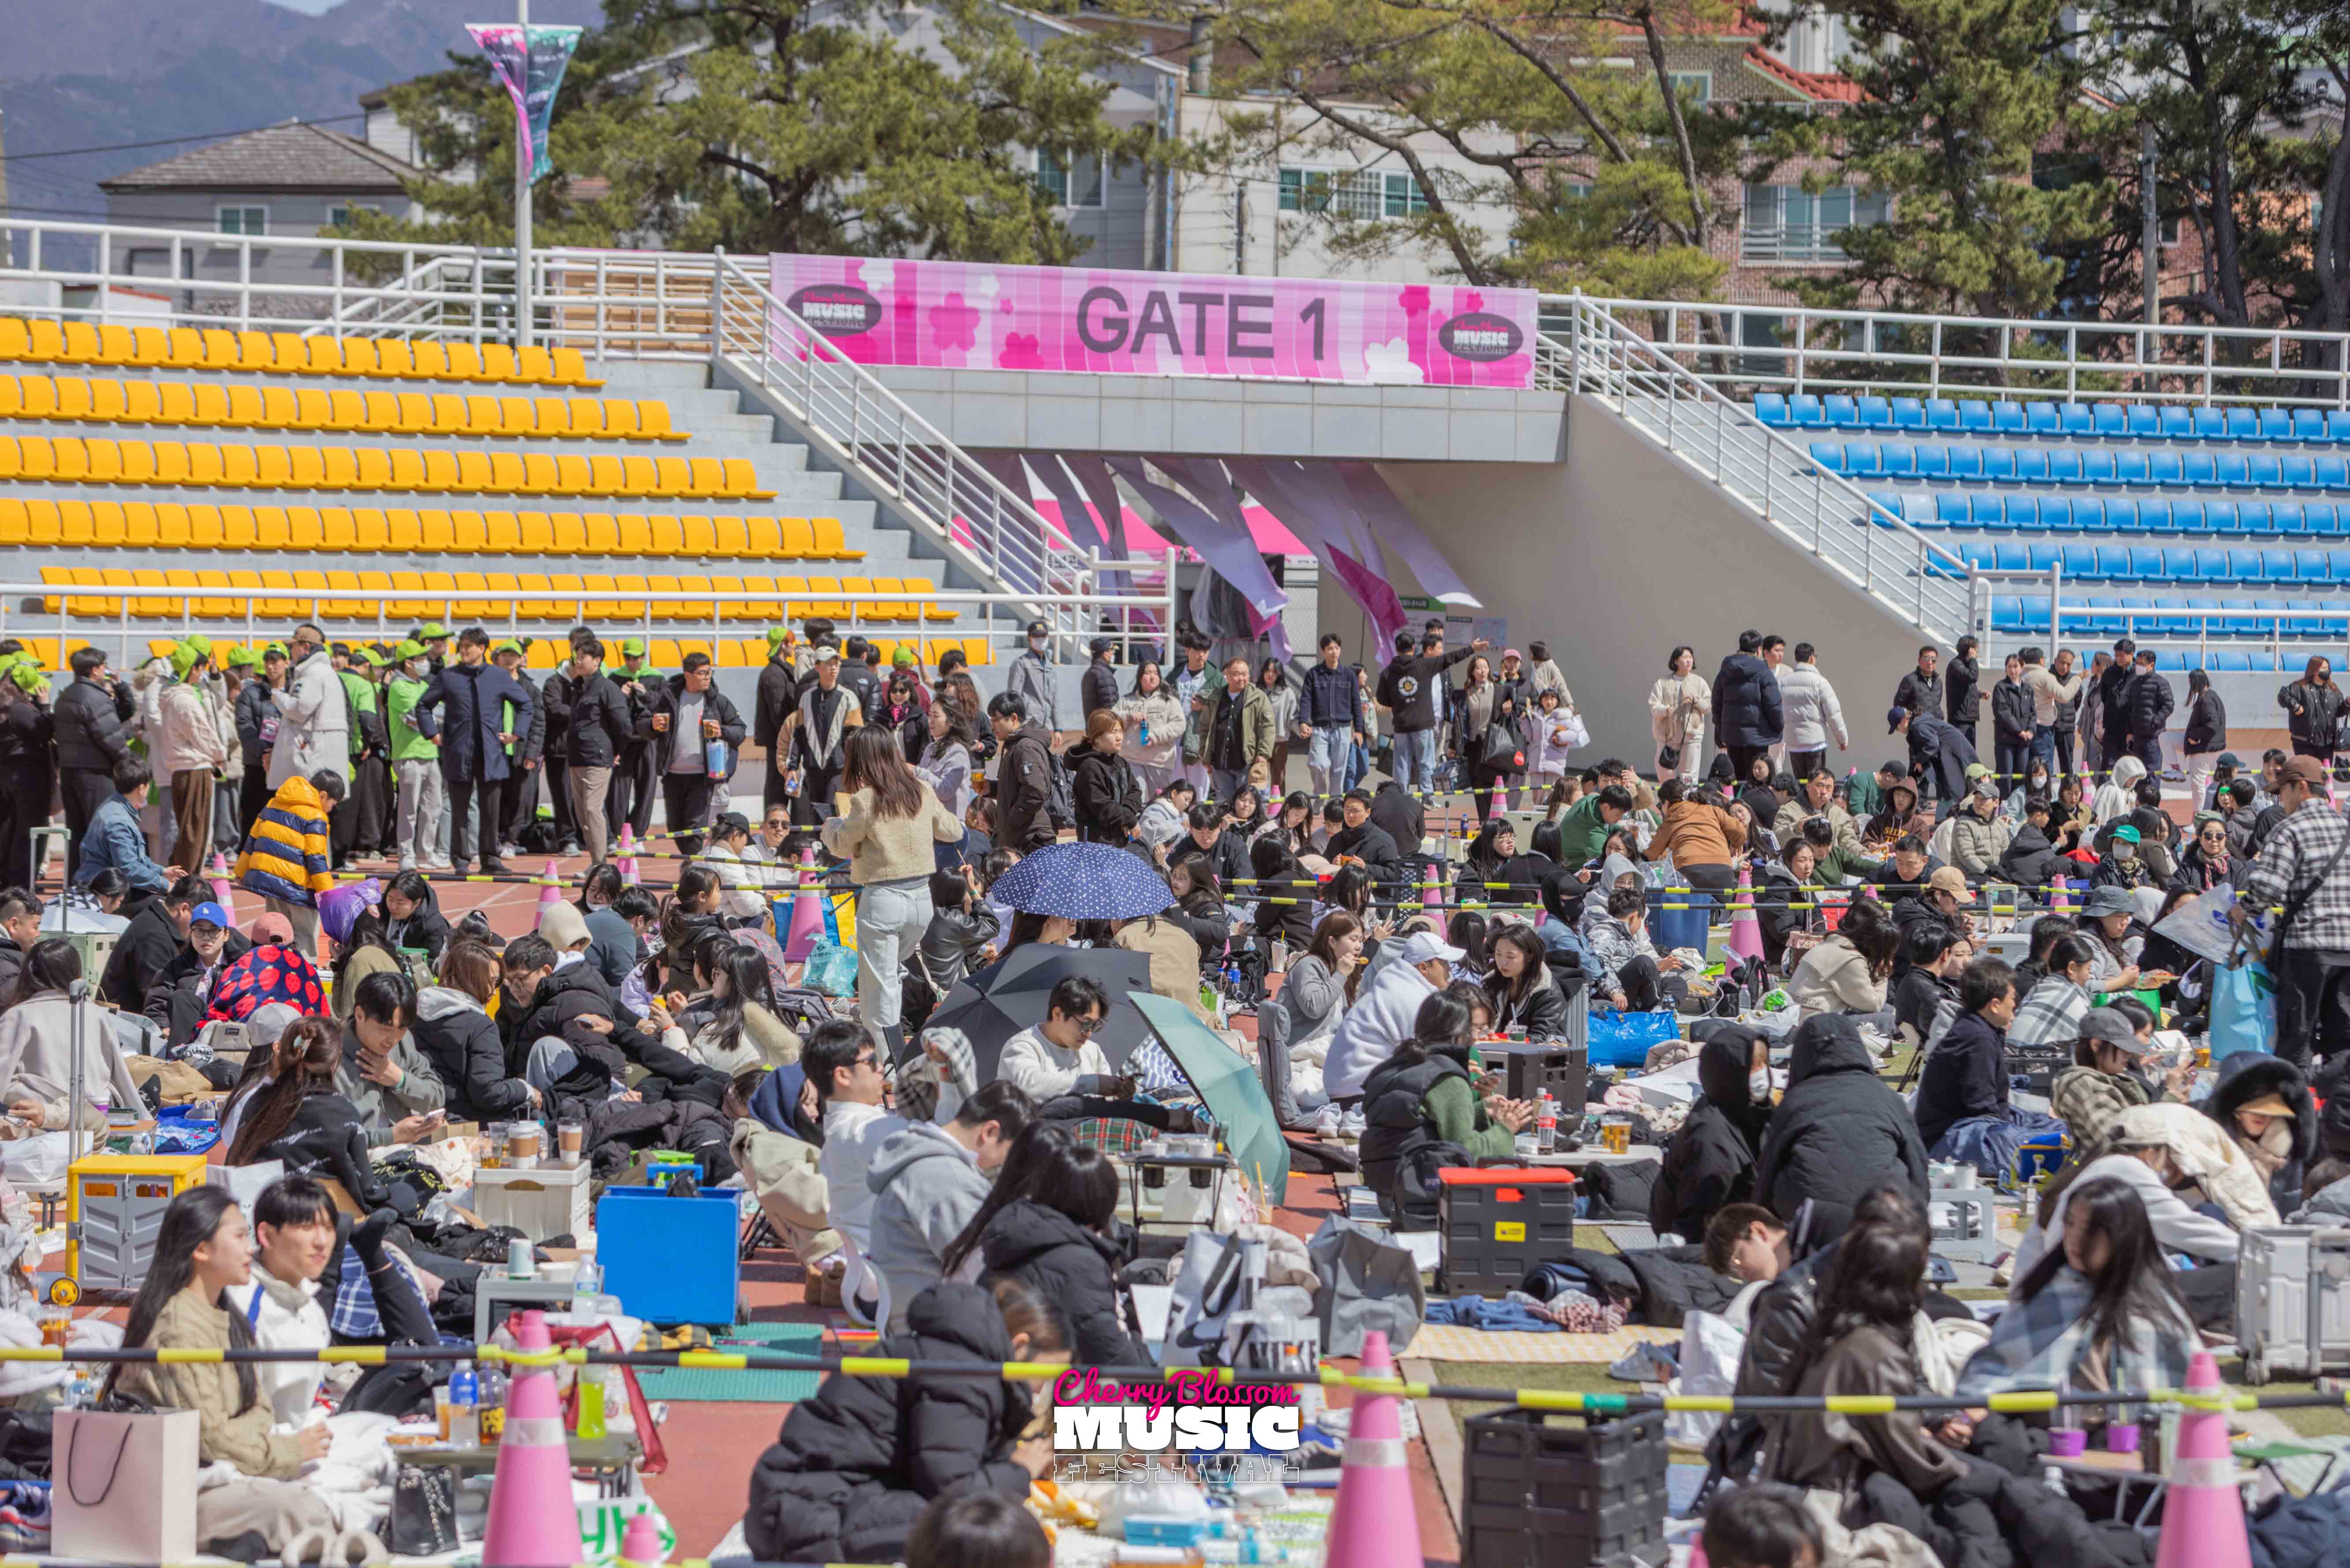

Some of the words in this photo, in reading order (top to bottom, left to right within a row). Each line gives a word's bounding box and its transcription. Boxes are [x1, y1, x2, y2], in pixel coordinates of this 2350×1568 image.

[802, 302, 865, 320] MUSIC
[1077, 286, 1274, 358] GATE
[1299, 297, 1325, 360] 1
[1453, 330, 1509, 346] MUSIC
